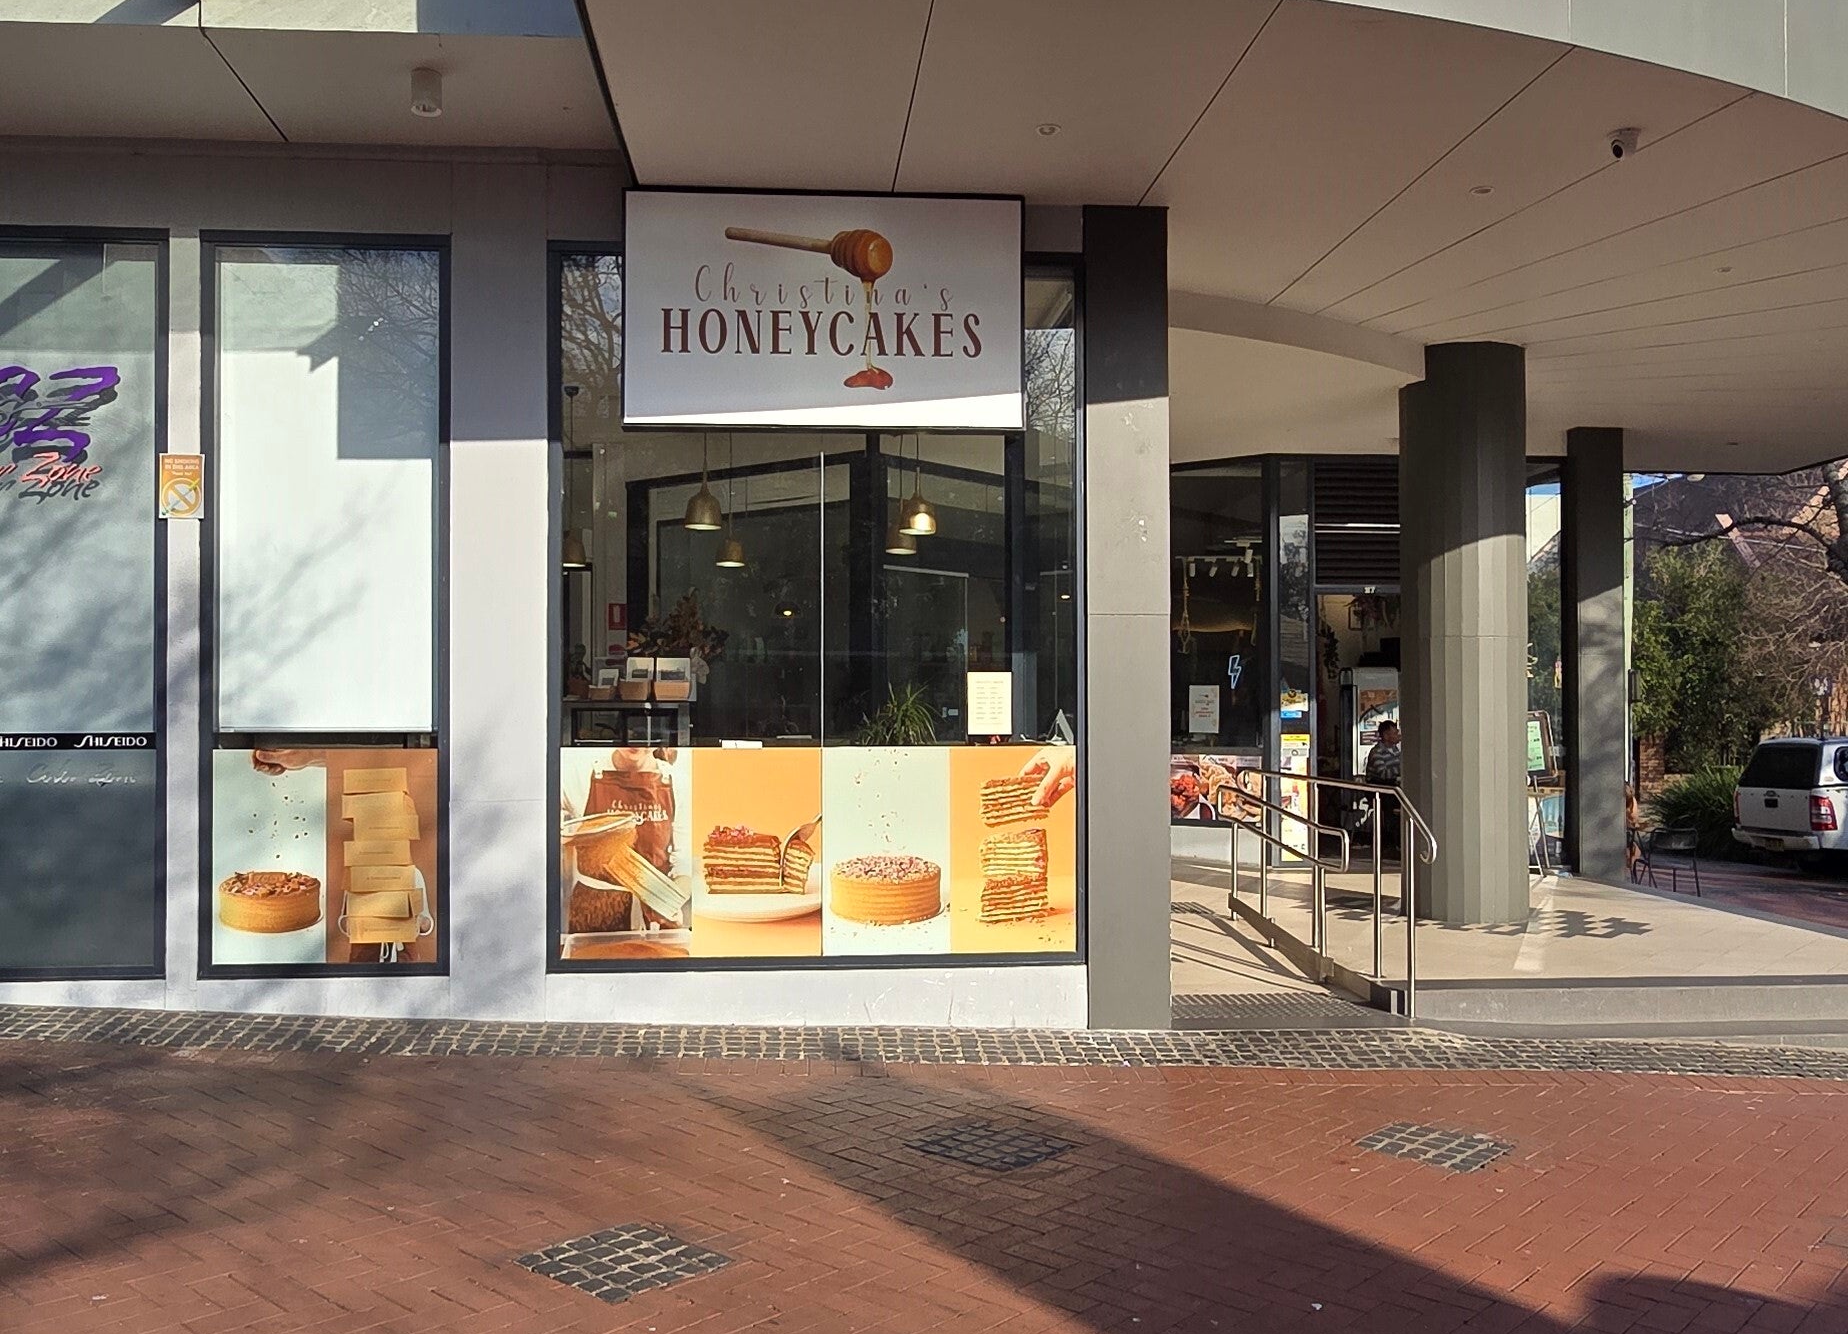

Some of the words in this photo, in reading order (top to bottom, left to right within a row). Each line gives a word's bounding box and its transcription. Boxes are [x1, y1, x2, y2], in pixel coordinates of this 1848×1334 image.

[694, 262, 954, 311] Christina's
[660, 307, 983, 358] HONEYCAKES
[22, 451, 103, 488] Zone
[0, 735, 58, 748] HISEIDO
[74, 734, 148, 748] SHISEIDO
